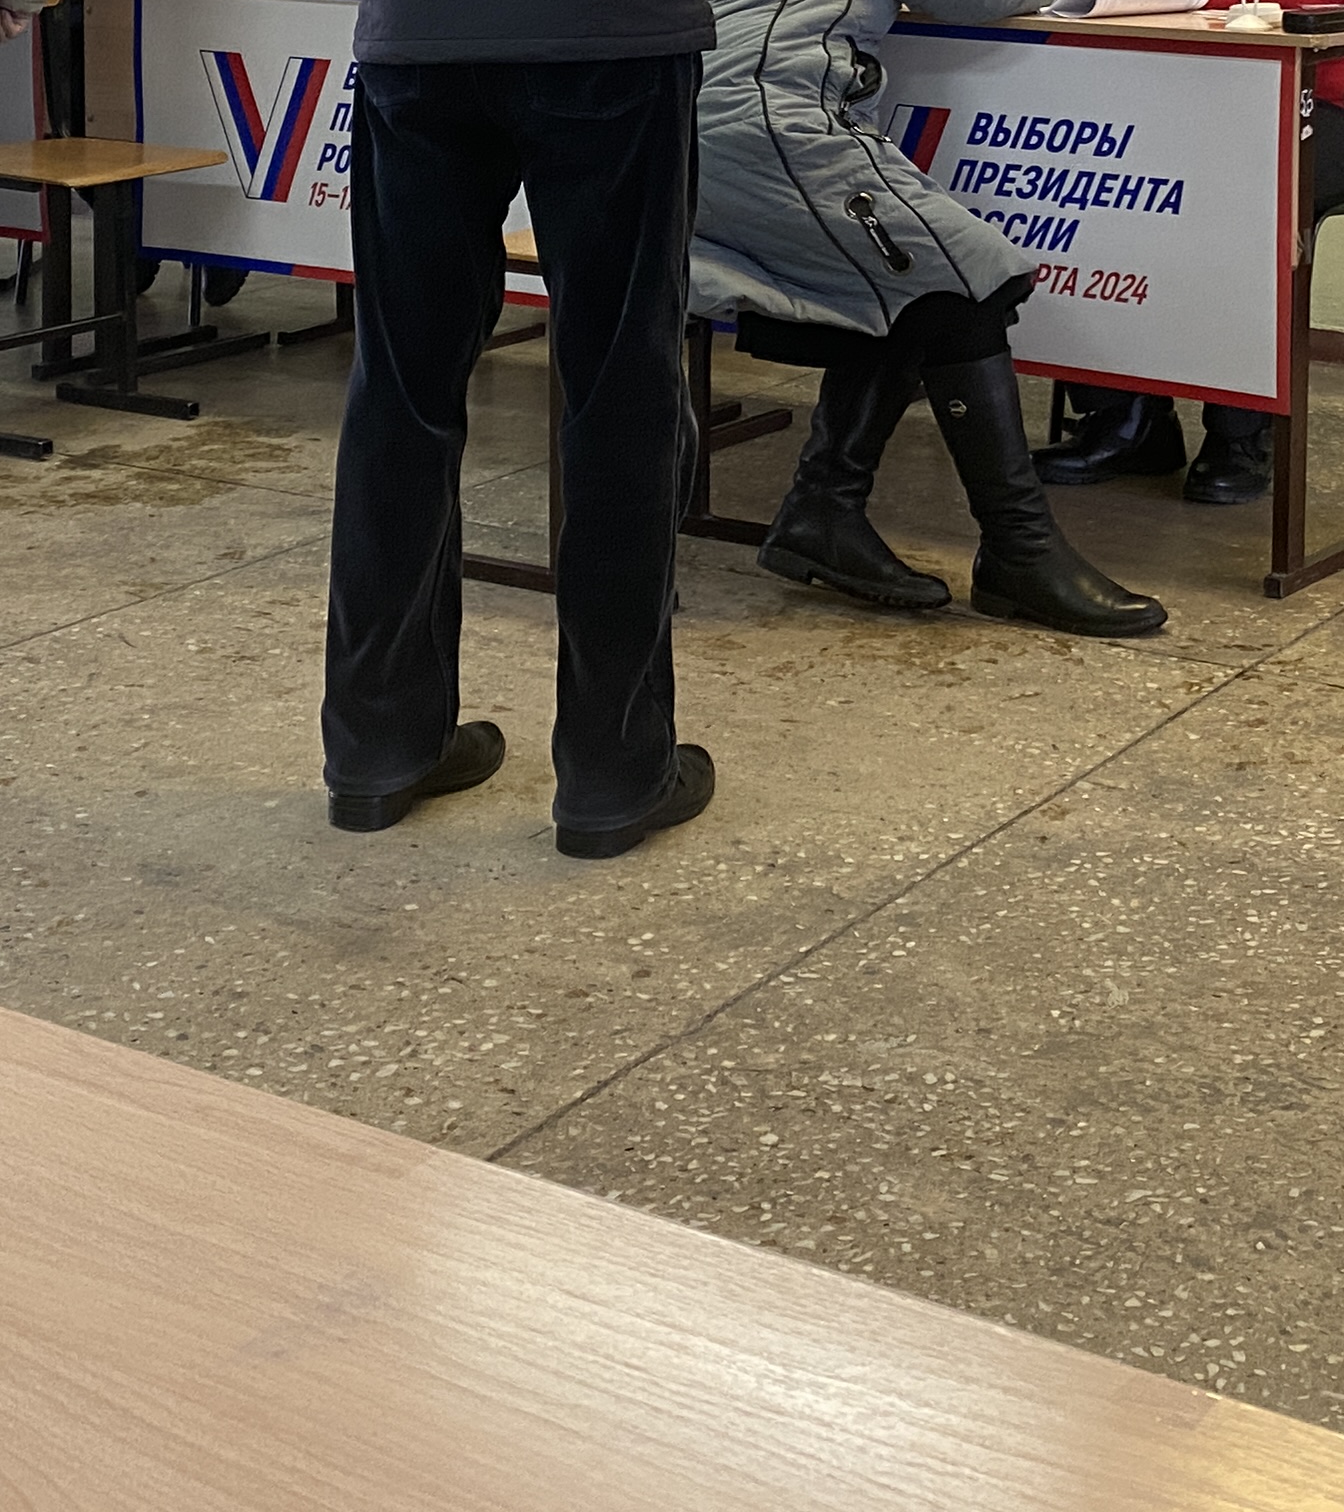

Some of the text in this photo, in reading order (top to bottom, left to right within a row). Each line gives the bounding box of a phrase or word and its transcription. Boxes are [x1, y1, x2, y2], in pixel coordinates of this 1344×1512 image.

[966, 112, 1135, 159] ВЫБОРЫ
[949, 158, 1185, 215] ПРЕЗИДЕНТА
[1032, 263, 1149, 305] РТА 2024
